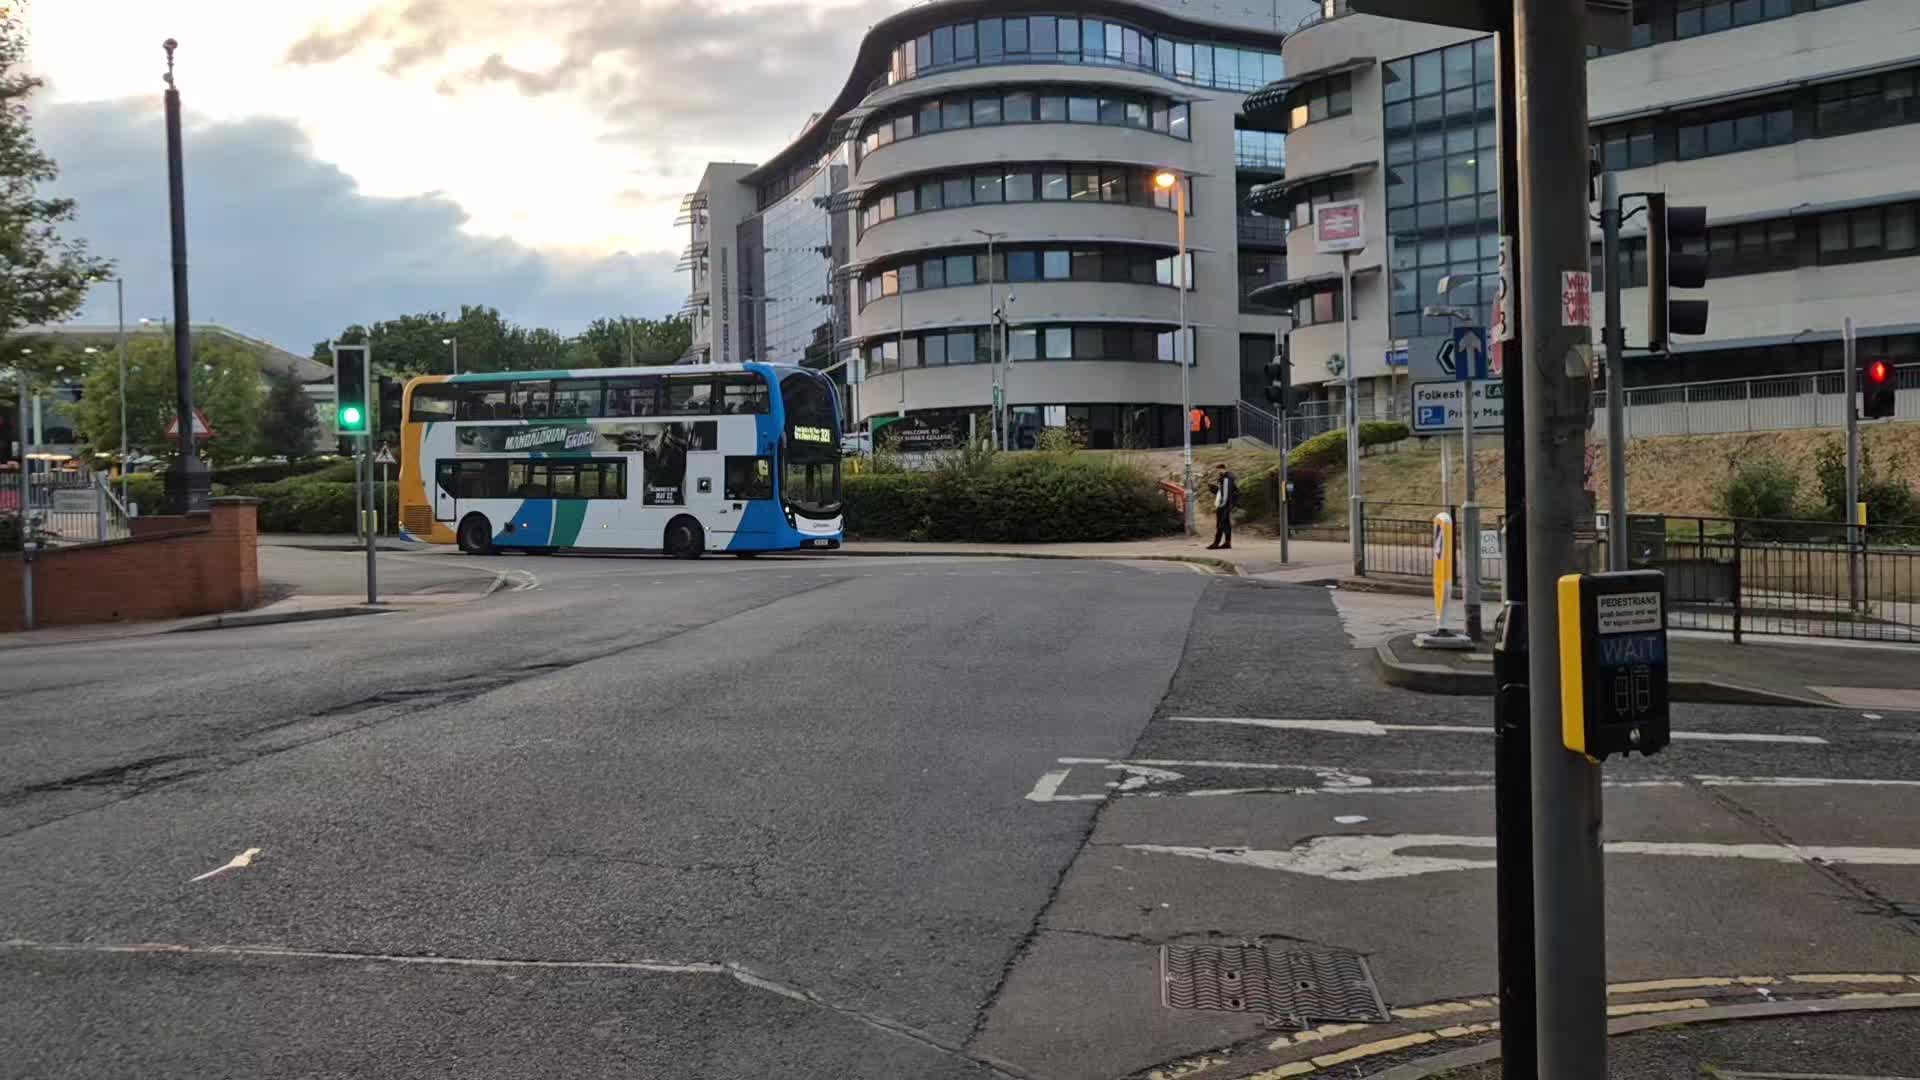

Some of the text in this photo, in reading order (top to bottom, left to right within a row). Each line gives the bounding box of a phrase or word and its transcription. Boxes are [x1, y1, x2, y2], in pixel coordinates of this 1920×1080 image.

[1418, 389, 1481, 400] Folkeste
[1448, 407, 1479, 418] Priy
[504, 427, 568, 450] MANDALORIAN
[565, 431, 596, 449] GROGU
[1600, 596, 1656, 608] PEDESTRIANS
[1601, 637, 1656, 664] WAIT
